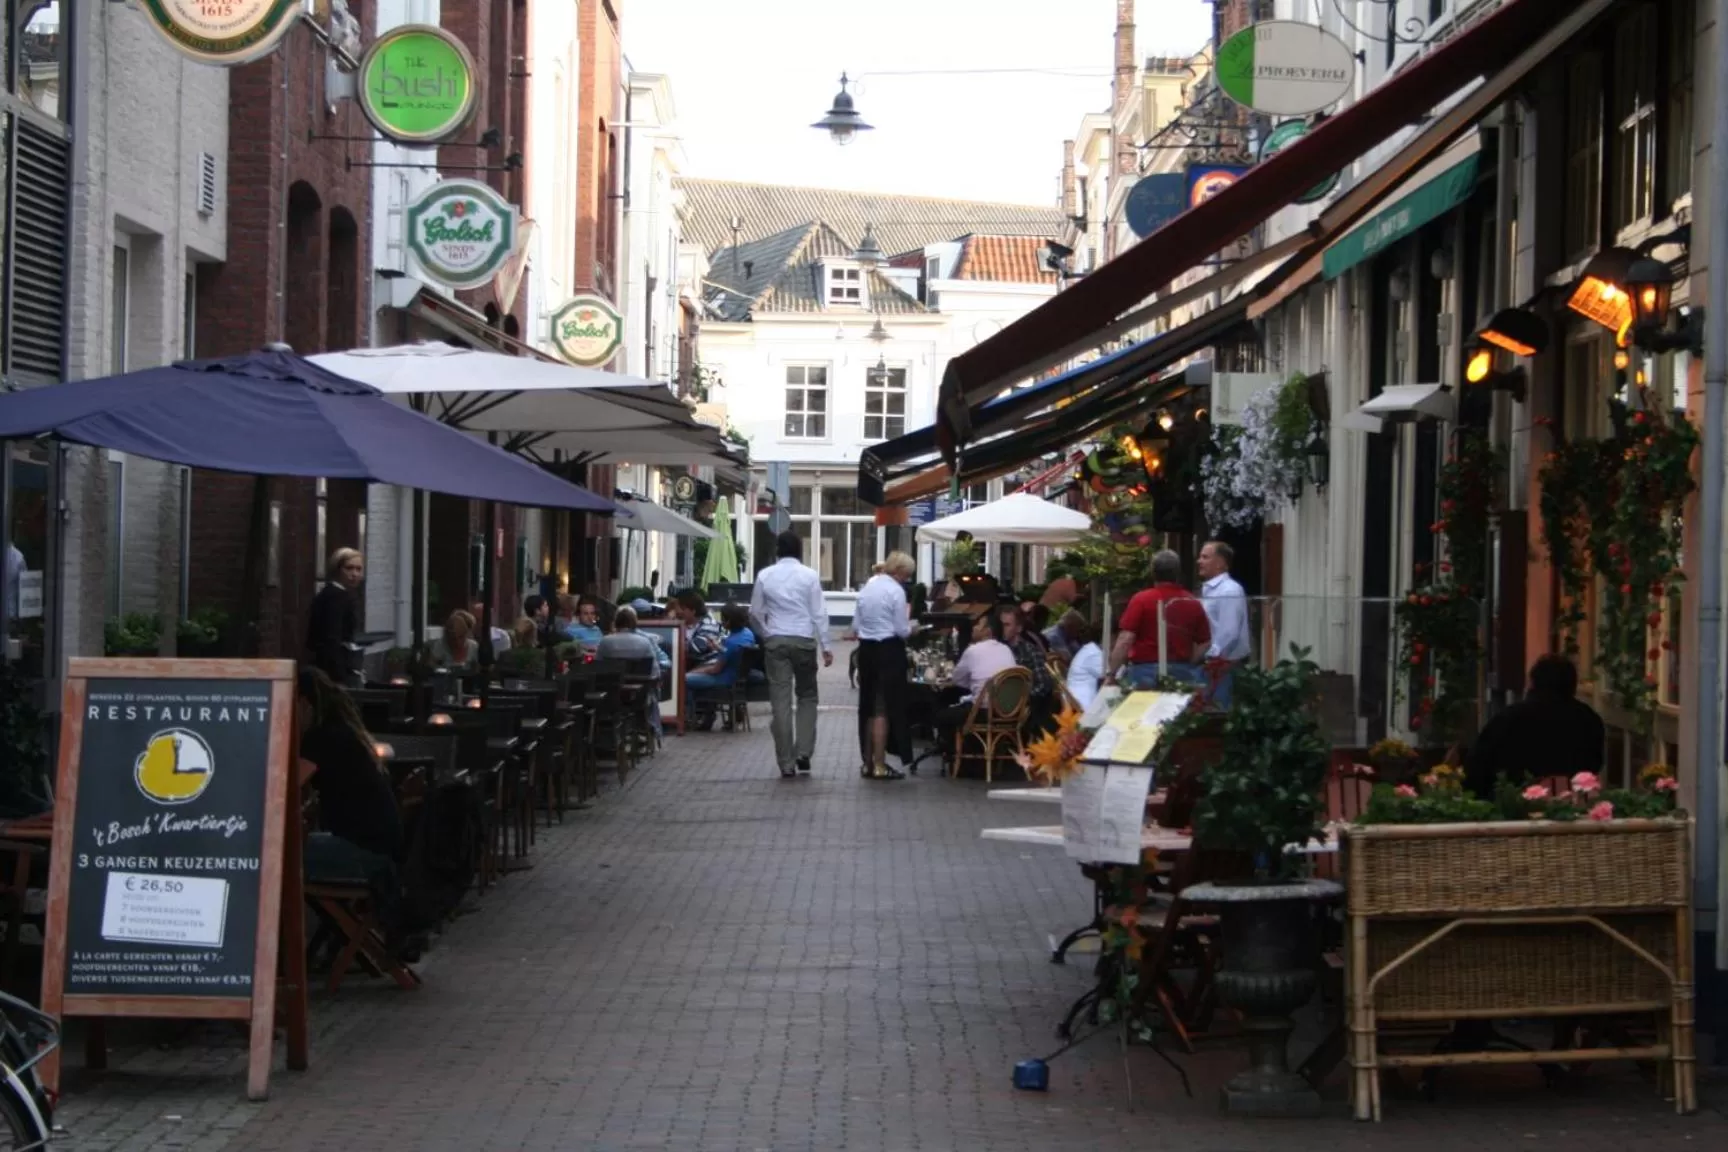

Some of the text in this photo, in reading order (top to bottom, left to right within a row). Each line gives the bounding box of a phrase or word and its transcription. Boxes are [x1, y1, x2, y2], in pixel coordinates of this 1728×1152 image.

[200, 4, 233, 17] 1615
[404, 56, 428, 67] THE
[1258, 65, 1346, 81] PROEVERIJ
[423, 215, 495, 245] Grolsch
[561, 320, 611, 339] Grolsch
[88, 705, 268, 722] RESTAURANT
[78, 854, 260, 870] 3 GANGEN KEUZEMENU
